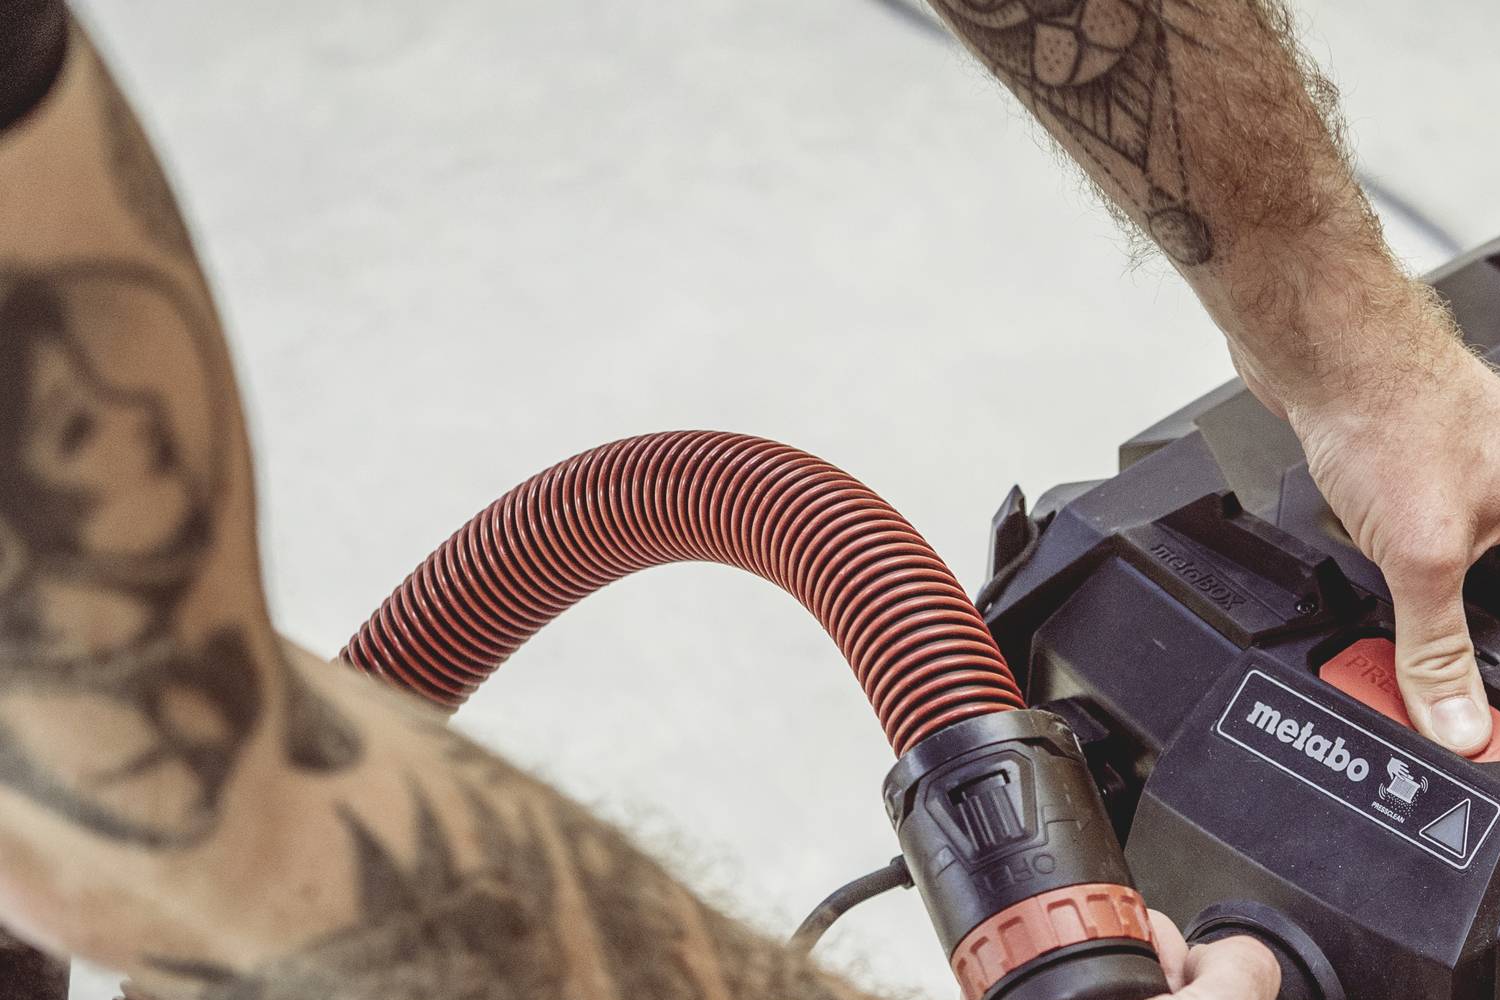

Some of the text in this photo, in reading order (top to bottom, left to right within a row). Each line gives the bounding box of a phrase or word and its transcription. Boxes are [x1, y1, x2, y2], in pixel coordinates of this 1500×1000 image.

[1344, 655, 1398, 694] PRE
[1245, 700, 1370, 782] metabo
[1371, 800, 1406, 824] PRESSCLEAN
